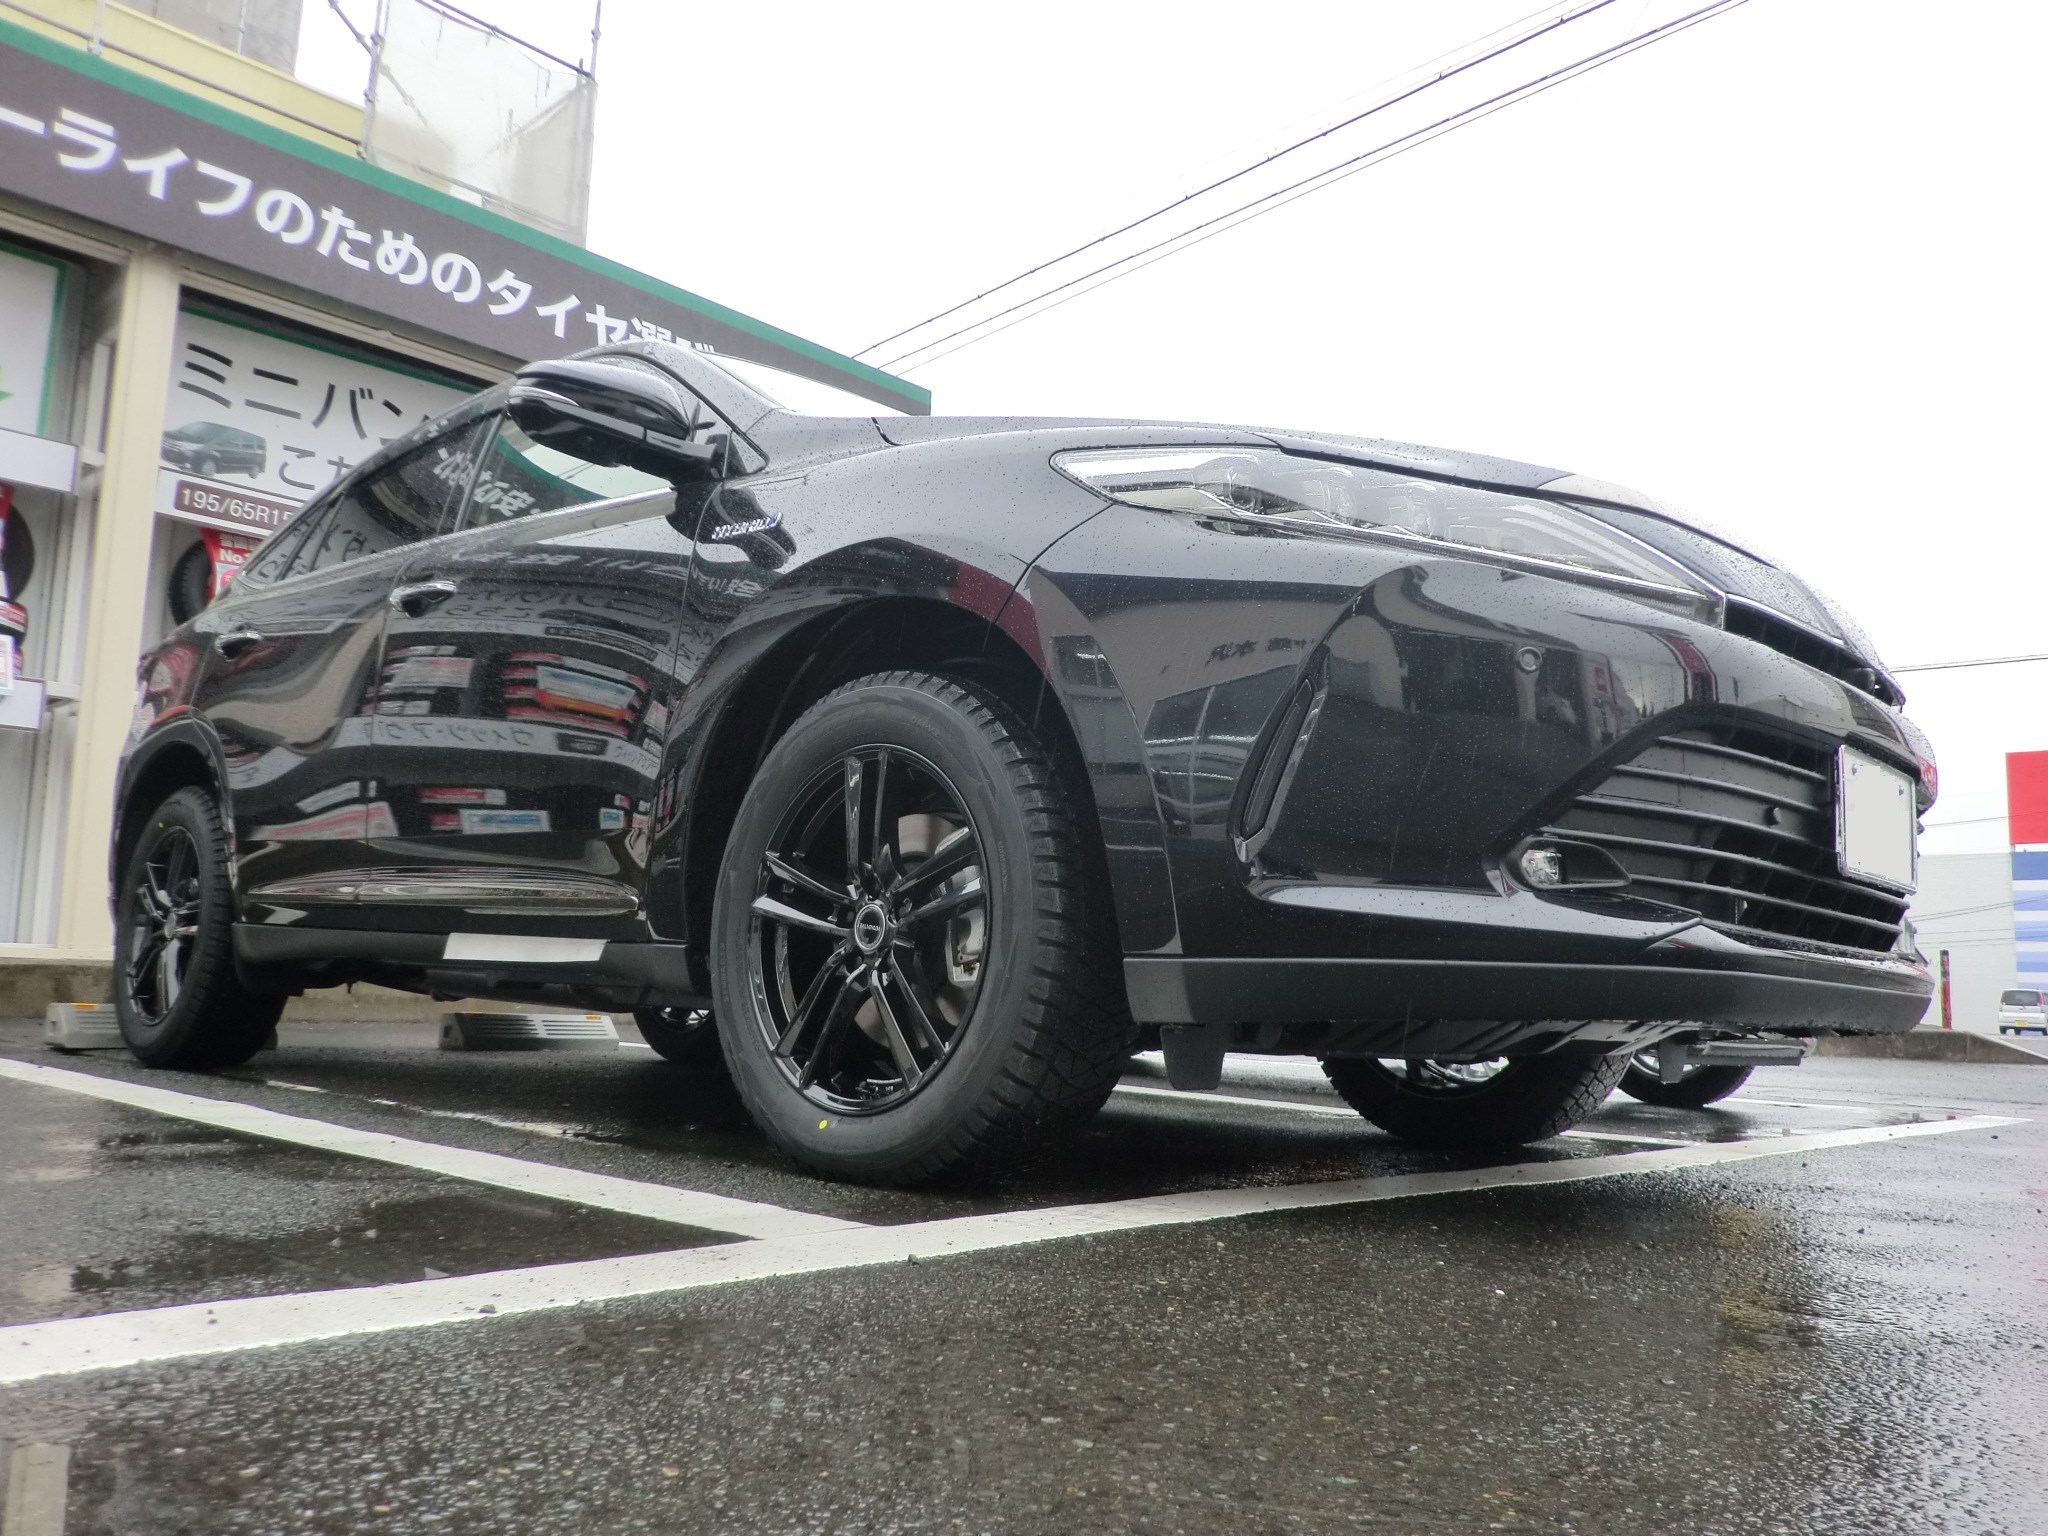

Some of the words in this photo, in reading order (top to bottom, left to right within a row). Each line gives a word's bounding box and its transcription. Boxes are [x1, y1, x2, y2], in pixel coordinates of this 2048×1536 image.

[0, 105, 714, 353] ーライフのためのタイヤ
